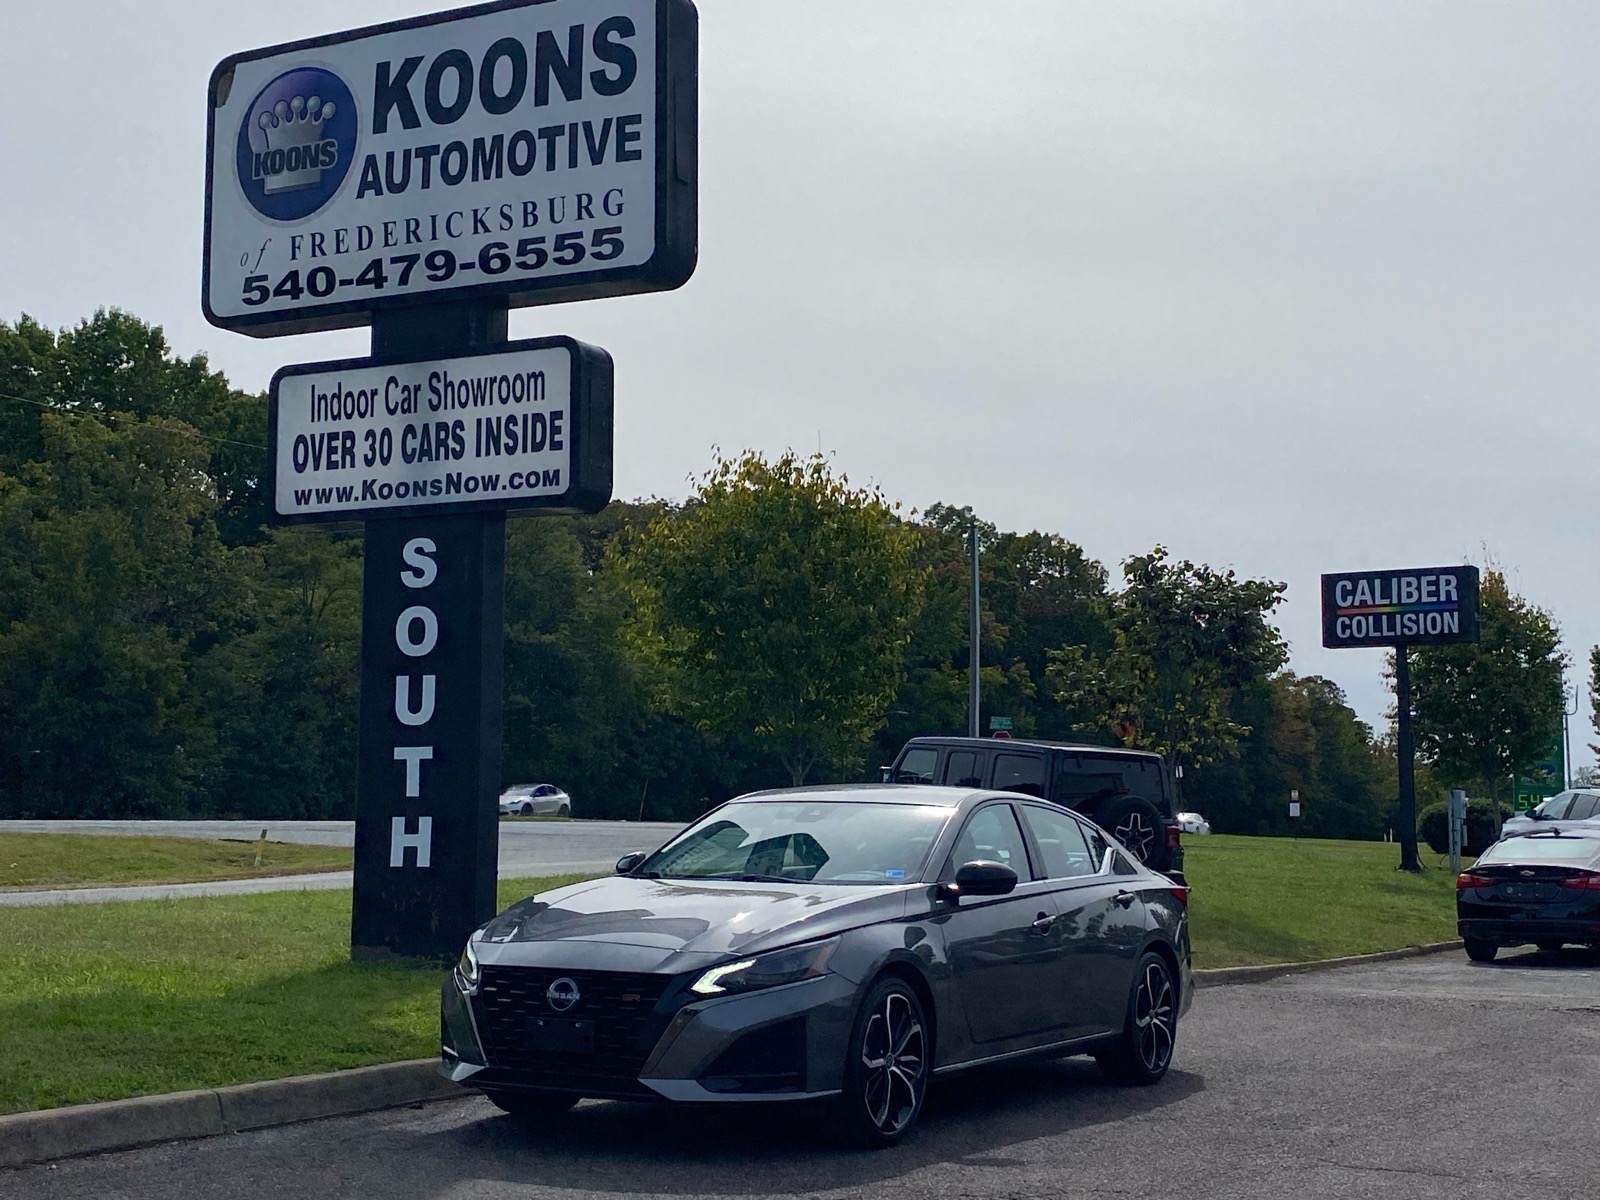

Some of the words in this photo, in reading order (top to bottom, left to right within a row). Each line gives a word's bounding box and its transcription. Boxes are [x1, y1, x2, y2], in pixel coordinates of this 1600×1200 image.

[372, 15, 638, 135] KOONS
[253, 141, 338, 179] KOONS
[355, 113, 643, 200] AUTOMOTIVE
[240, 238, 272, 274] of
[290, 188, 626, 261] FREDERICKSBURG
[241, 226, 625, 306] 540-479-6555
[310, 382, 379, 423] Indoor
[384, 375, 422, 416] Car
[427, 370, 546, 412] Showroom
[292, 430, 356, 474] OVER
[363, 427, 393, 468] 30
[401, 419, 466, 465] CARS
[475, 410, 564, 458] INSIDE
[1335, 574, 1458, 608] CALIBER
[1336, 611, 1460, 639] COLLISION
[389, 537, 439, 868] SOUTH
[546, 989, 580, 1001] NISSAN
